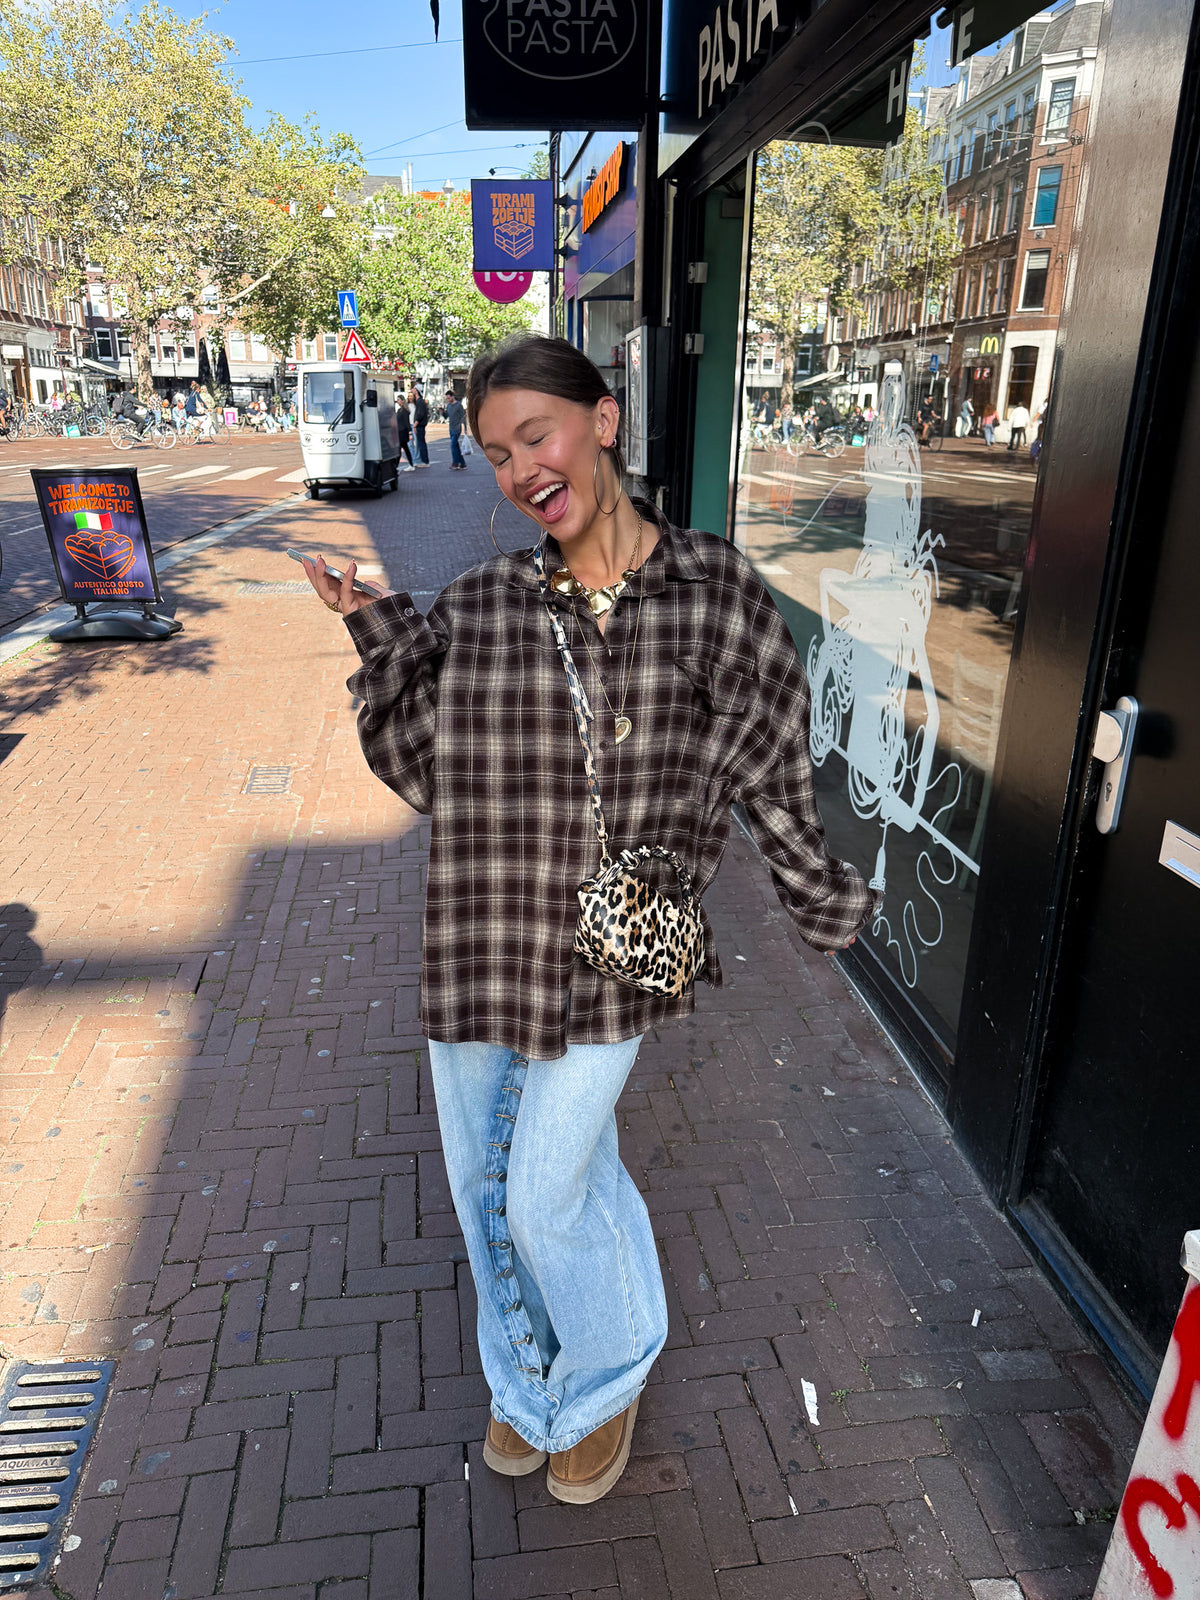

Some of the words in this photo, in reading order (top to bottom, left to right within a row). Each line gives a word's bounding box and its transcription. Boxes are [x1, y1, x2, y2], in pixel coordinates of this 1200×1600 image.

[507, 19, 618, 54] PASTA
[490, 193, 535, 208] TIRAMI
[492, 207, 536, 227] ZOETJE
[48, 483, 115, 500] WELCOME
[116, 485, 130, 496] TO
[48, 497, 135, 516] TIRAMIZOETJE
[0, 1458, 57, 1469] AQUAAY
